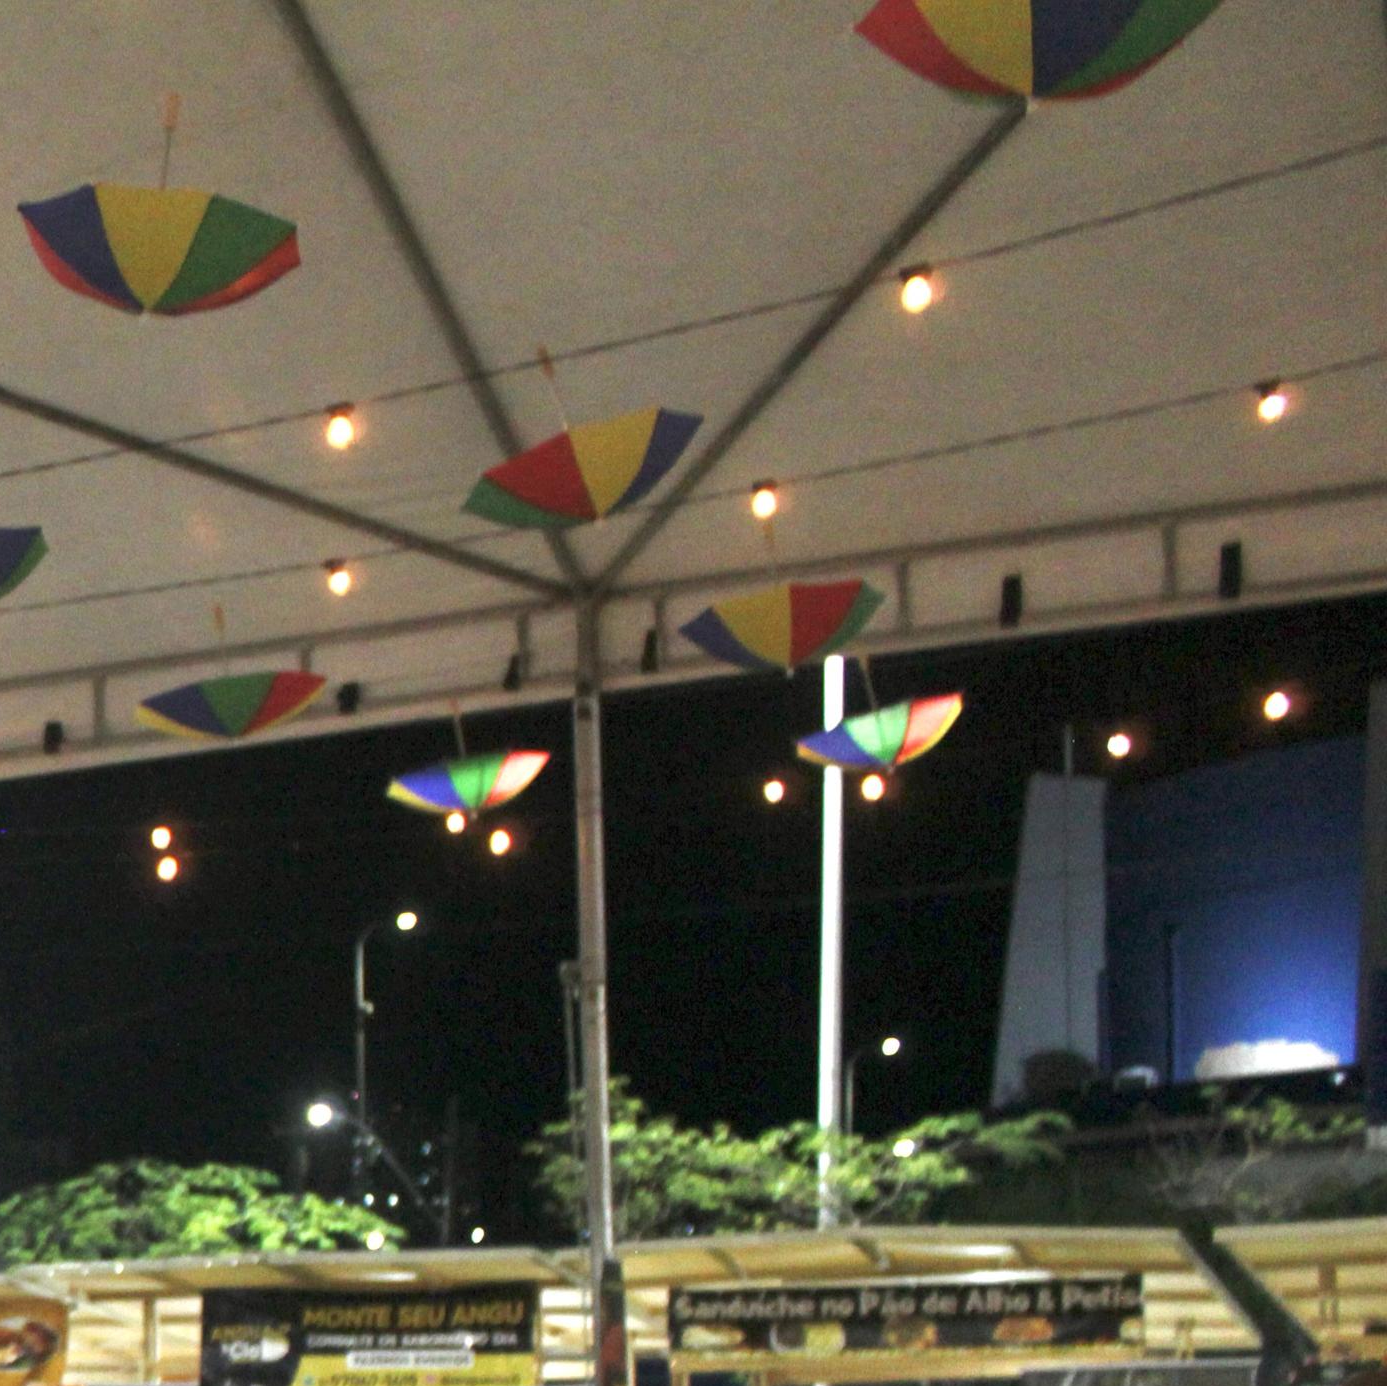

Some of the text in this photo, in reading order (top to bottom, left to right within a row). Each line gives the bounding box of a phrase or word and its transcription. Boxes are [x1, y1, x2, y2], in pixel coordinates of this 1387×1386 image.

[303, 1300, 524, 1328] MONTE SEU ANGU
